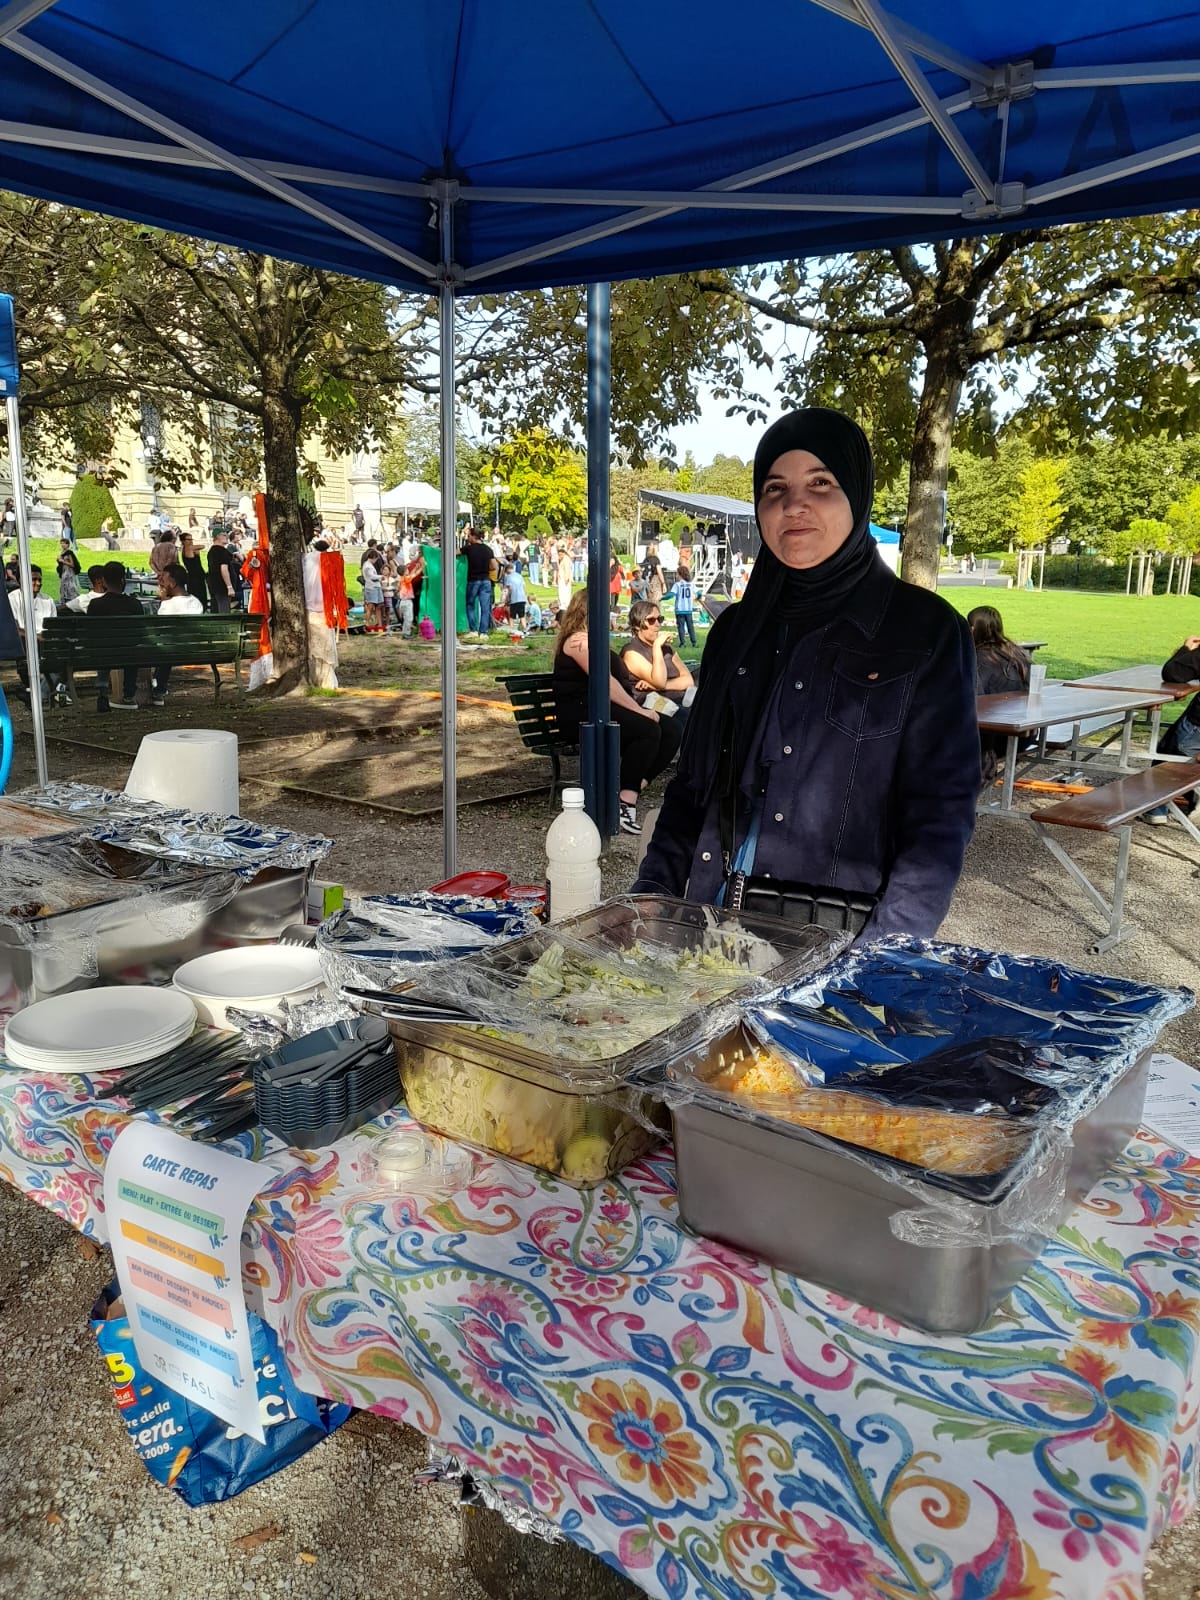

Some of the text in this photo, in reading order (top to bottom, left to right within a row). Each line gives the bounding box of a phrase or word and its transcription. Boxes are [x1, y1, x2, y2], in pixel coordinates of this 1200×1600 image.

[682, 588, 691, 599] 10
[142, 1154, 218, 1191] CARTE REPAS
[139, 1192, 154, 1205] PLAT
[192, 1214, 219, 1231] DESSERT
[182, 1372, 215, 1401] FASL
[140, 1401, 171, 1424] della
[145, 1442, 174, 1460] 2009.
